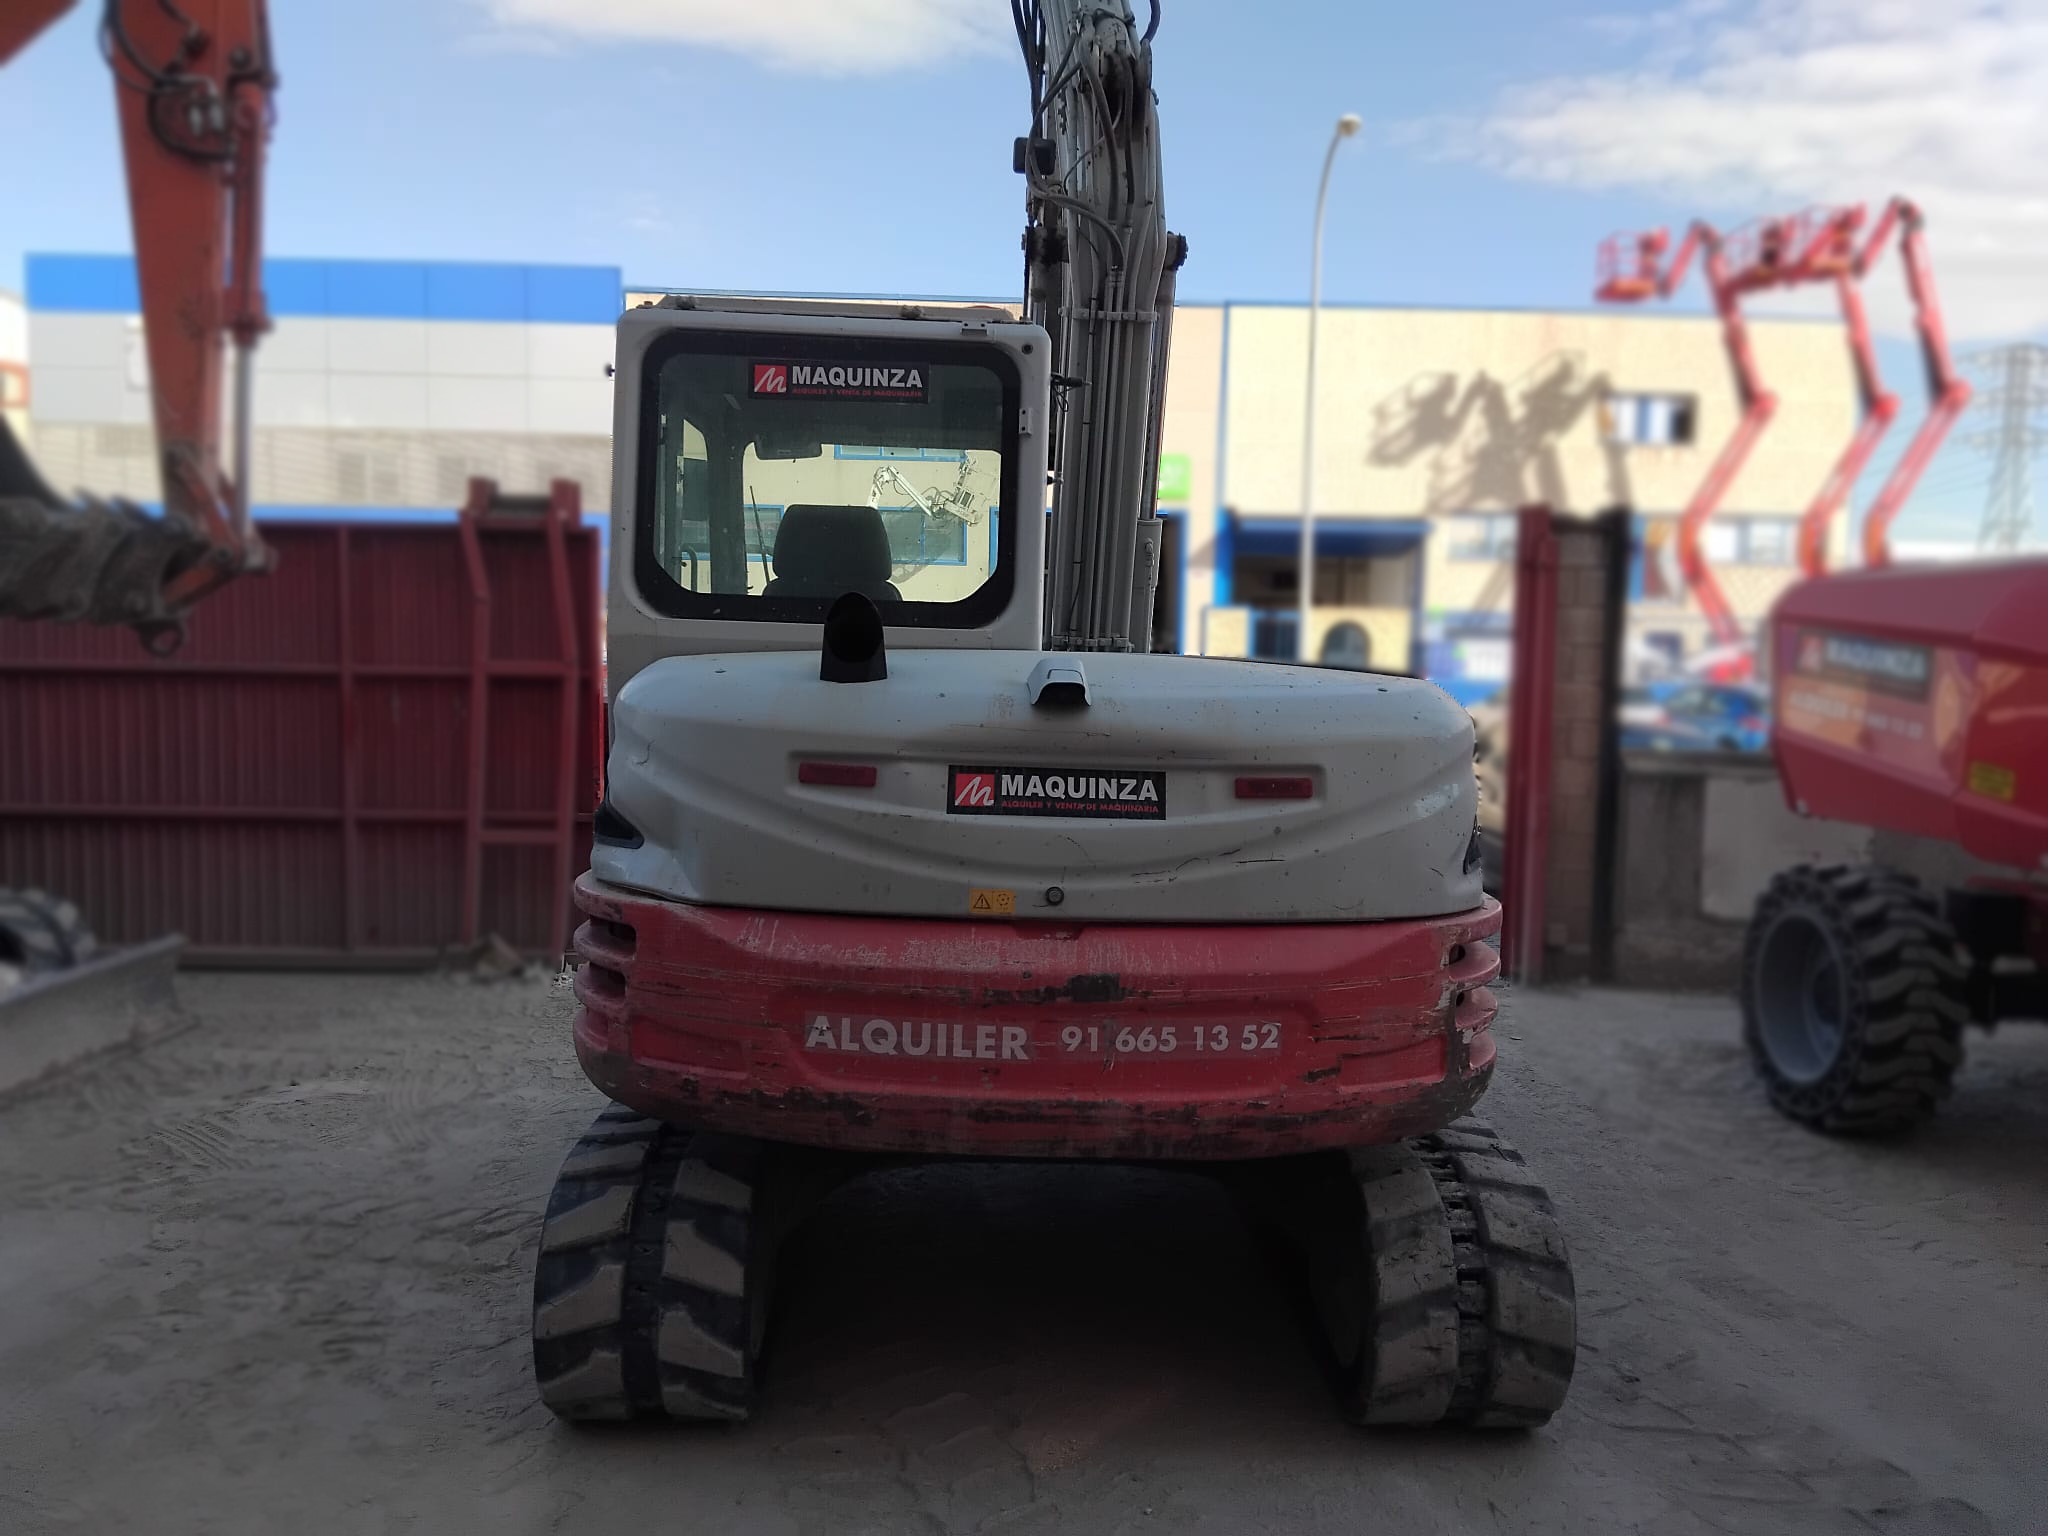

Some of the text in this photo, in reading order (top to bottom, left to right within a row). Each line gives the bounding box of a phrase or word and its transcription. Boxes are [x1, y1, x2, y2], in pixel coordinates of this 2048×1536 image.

[792, 366, 922, 388] MAQUINZA
[1001, 774, 1159, 801] MAQUINZA
[1001, 800, 1044, 809] ALQUILER
[1055, 801, 1082, 811] VENTA
[1085, 803, 1097, 811] DE
[1099, 803, 1159, 813] MAQUINARIA
[805, 1014, 1281, 1061] ALQUILER 91 665 13 52
